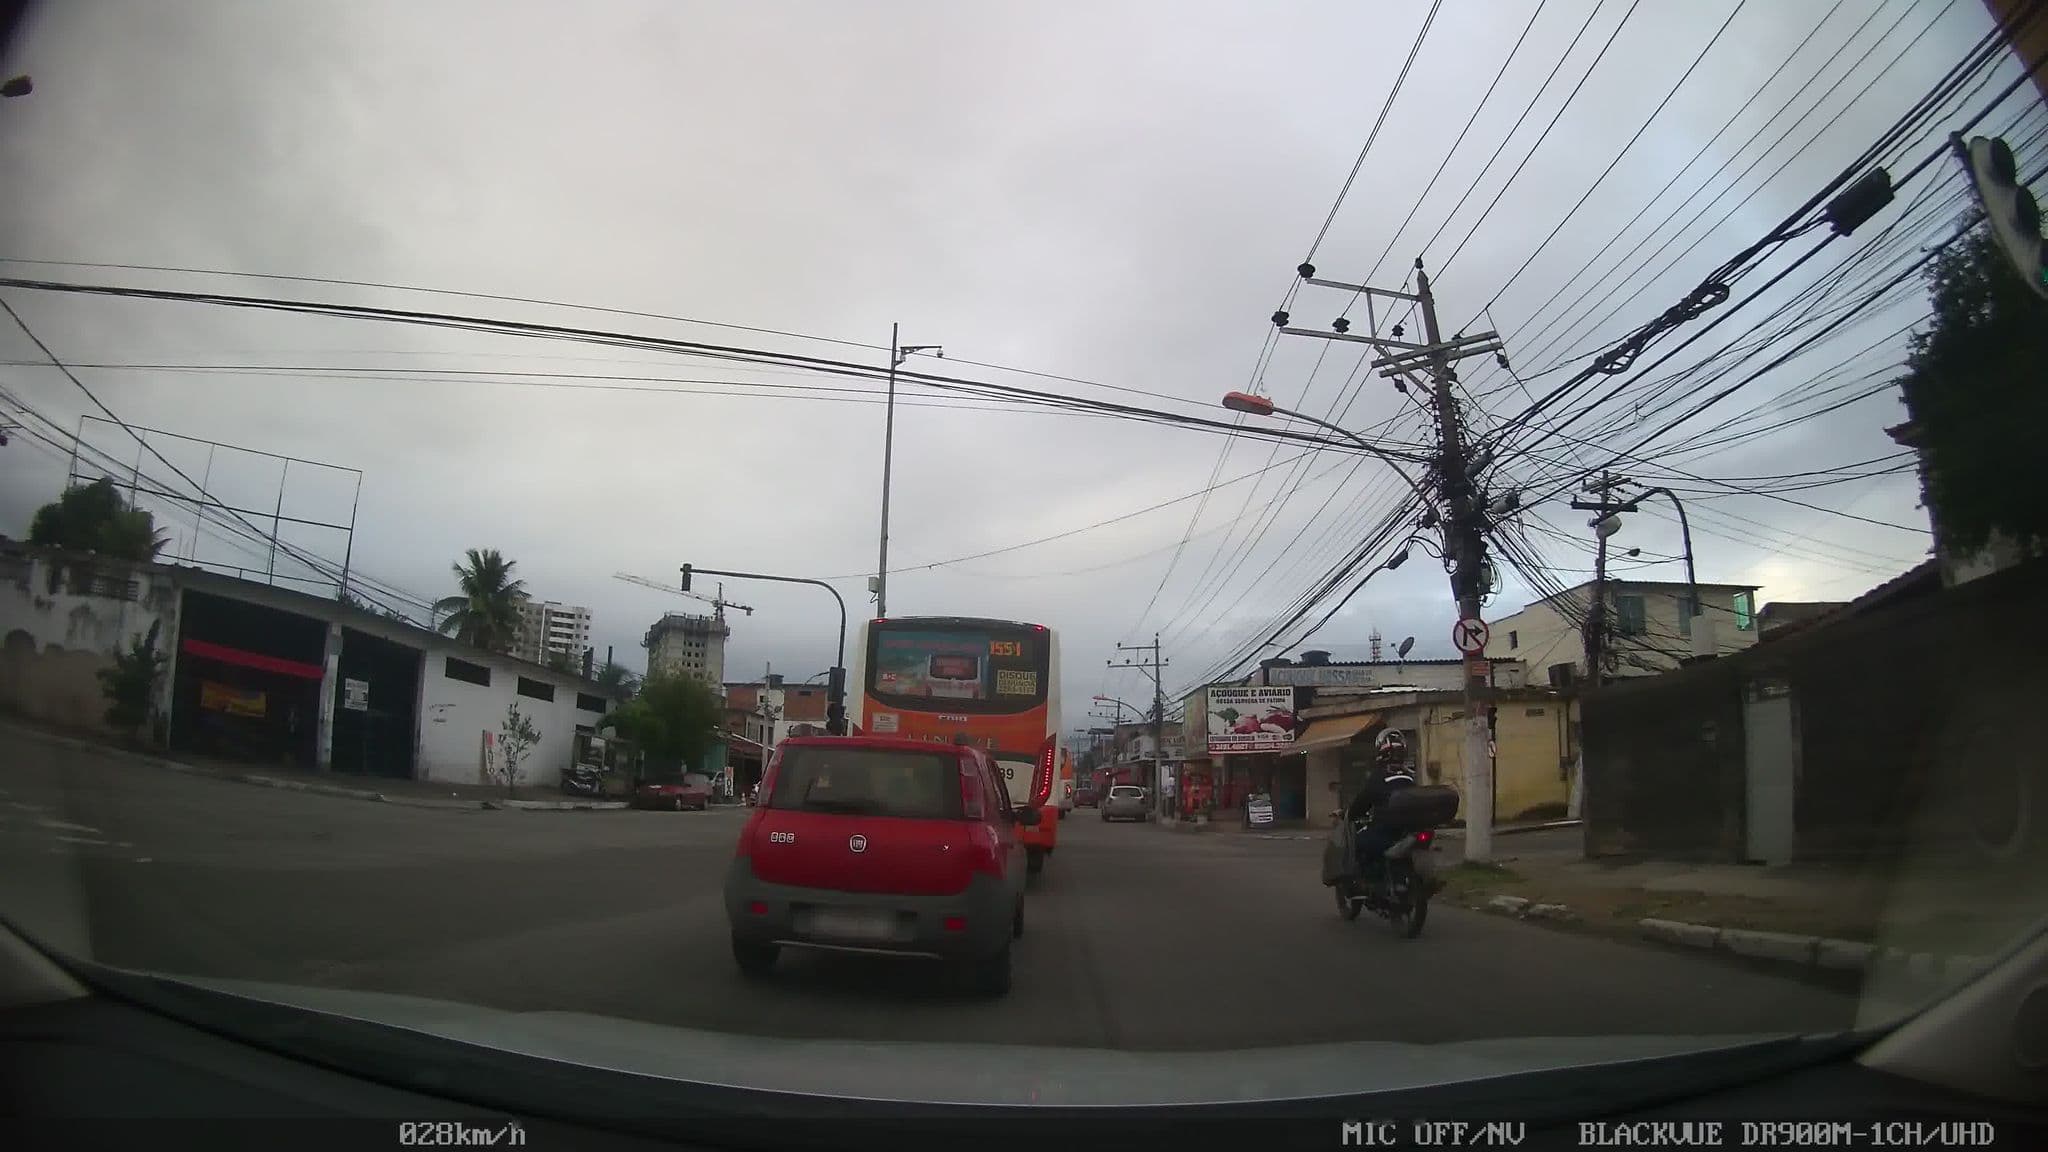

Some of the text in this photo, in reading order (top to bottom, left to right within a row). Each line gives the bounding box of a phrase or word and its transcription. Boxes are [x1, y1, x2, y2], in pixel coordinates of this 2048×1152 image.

[999, 671, 1036, 680] DISQUE
[1210, 689, 1249, 699] AÇOUGUE
[1251, 689, 1257, 697] E
